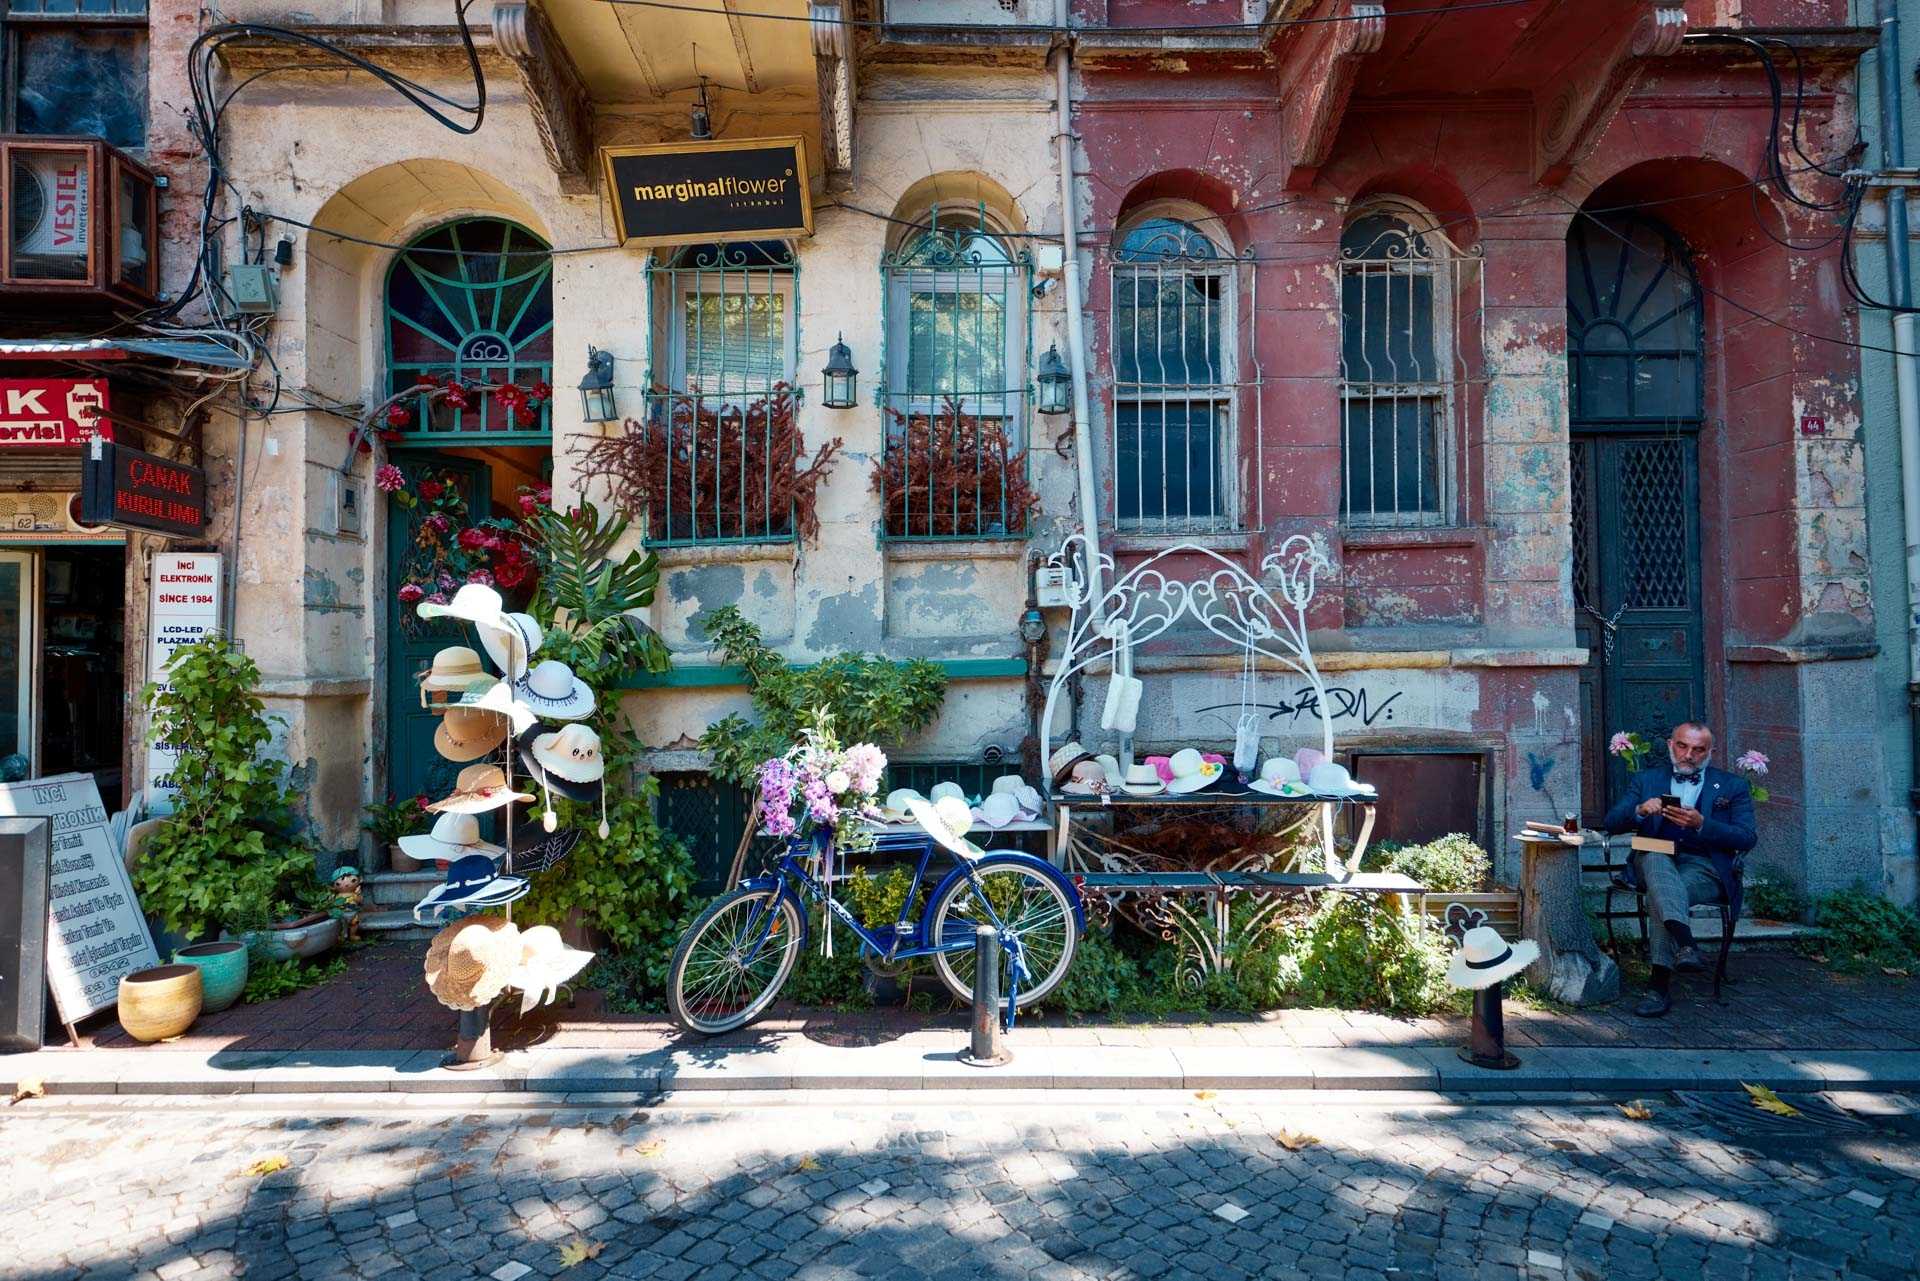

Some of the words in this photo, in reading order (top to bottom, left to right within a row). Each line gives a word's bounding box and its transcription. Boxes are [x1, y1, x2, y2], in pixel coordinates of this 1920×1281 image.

[54, 164, 77, 245] VESTEL
[471, 341, 501, 360] 60
[128, 458, 193, 496] ÇANAK
[115, 489, 201, 526] KURULUMU
[18, 518, 32, 529] 62
[177, 560, 195, 570] İNCİ
[160, 573, 213, 583] ELEKTRONİK
[159, 592, 188, 603] SİNCE
[191, 595, 213, 604] 1984
[163, 626, 203, 634] LCD-LED
[157, 637, 196, 645] PLAZMA
[32, 784, 67, 805] İNCİ
